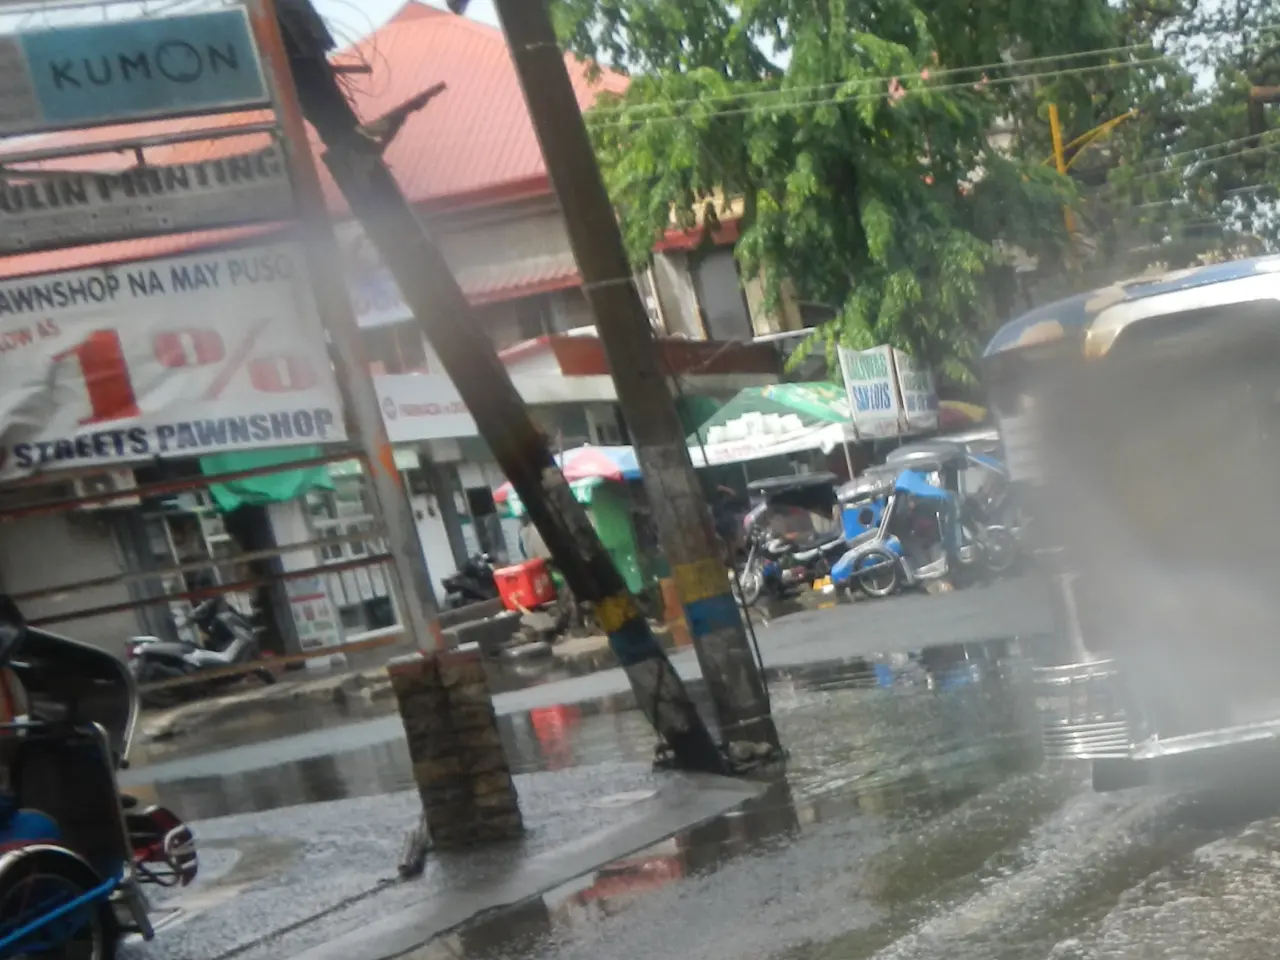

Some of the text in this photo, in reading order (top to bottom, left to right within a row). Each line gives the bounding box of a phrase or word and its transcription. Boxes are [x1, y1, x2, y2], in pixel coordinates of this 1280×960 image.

[48, 41, 240, 91] KUMON
[0, 151, 282, 214] ULIN PRINTING
[0, 272, 120, 316] AWNSHOP
[126, 268, 167, 298] NA
[170, 260, 219, 294] MAY
[0, 326, 34, 354] OW
[52, 319, 319, 425] 1%
[13, 406, 334, 469] STREETS PAWNSHOP
